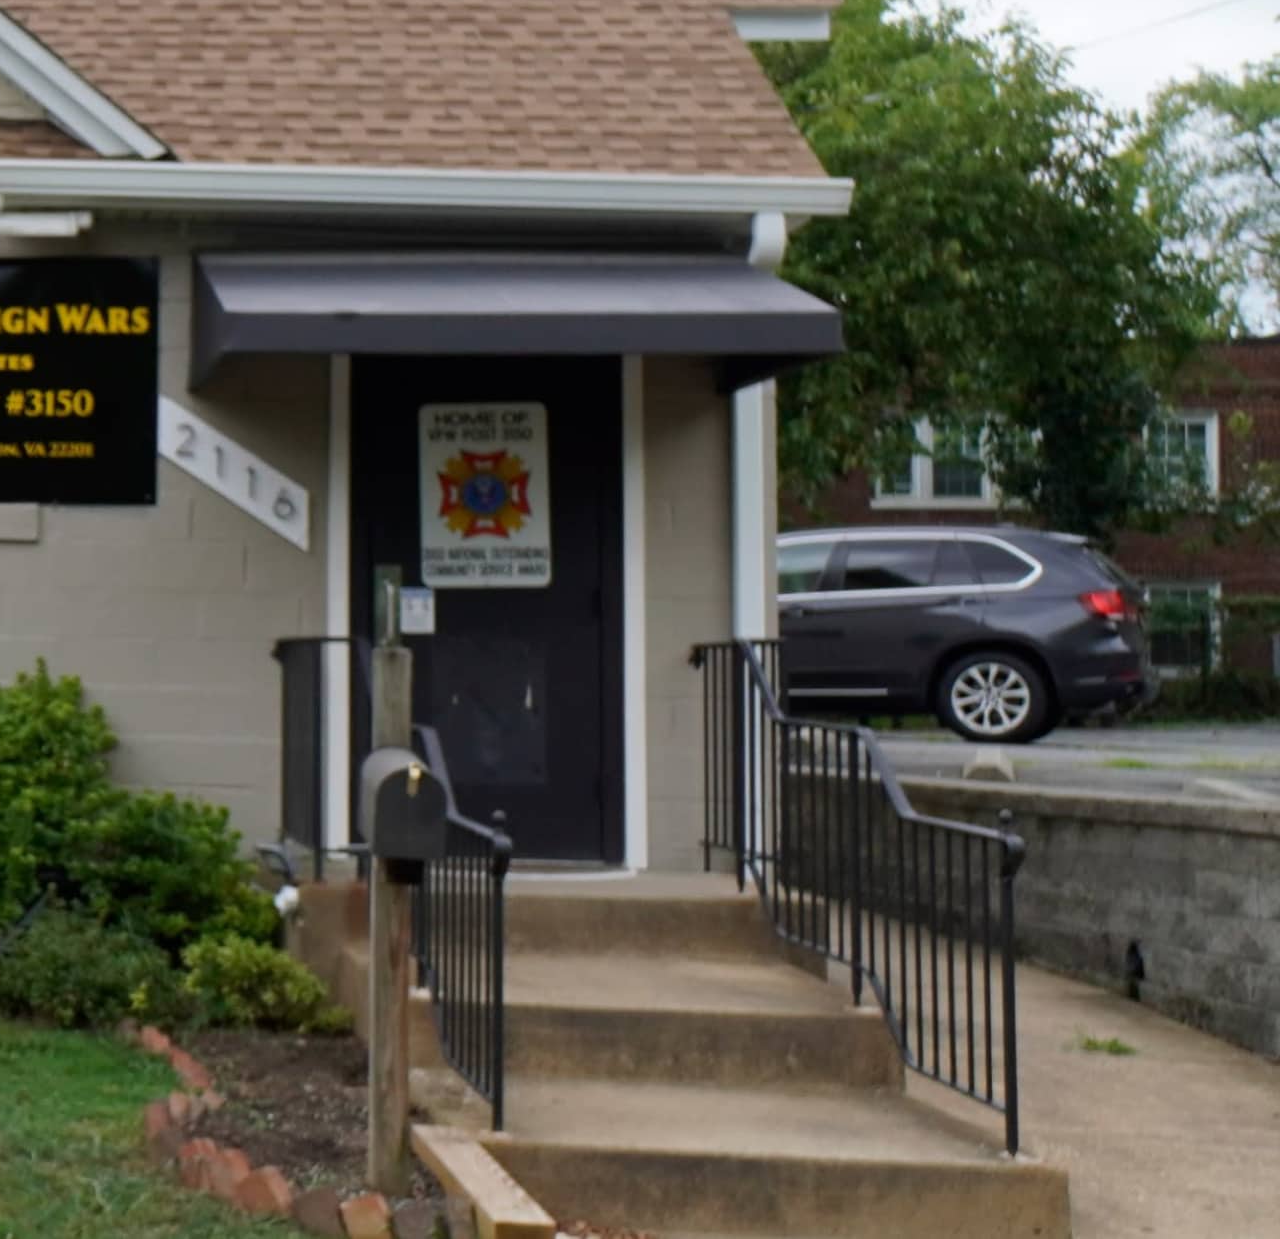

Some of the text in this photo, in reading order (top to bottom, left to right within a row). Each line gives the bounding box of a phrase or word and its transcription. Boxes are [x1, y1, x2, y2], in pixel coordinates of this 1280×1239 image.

[55, 303, 150, 334] WARS
[6, 388, 95, 417] #3150
[433, 410, 528, 426] HOME OF
[175, 422, 297, 522] 2116
